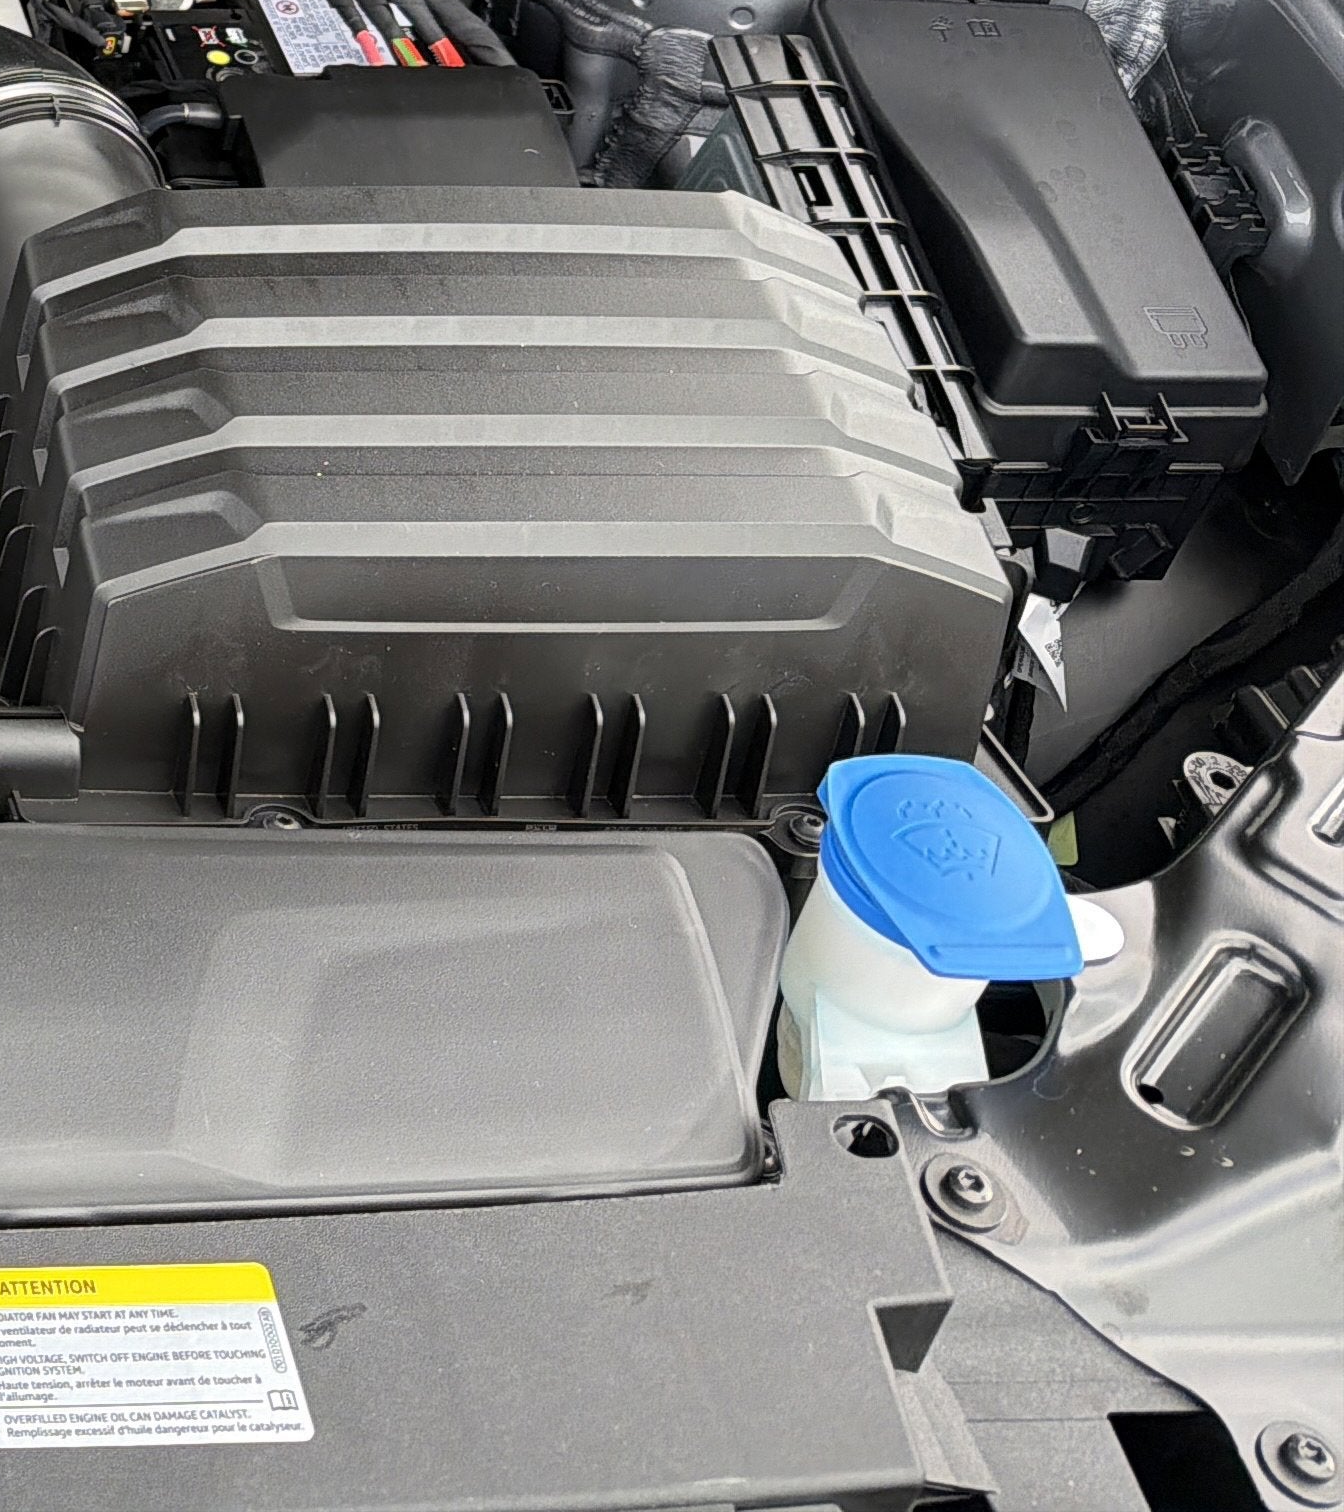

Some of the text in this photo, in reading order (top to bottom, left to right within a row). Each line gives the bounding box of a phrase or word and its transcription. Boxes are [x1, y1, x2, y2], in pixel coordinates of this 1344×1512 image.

[0, 1279, 96, 1295] ATTENTION
[35, 1311, 56, 1321] FAN
[57, 1311, 79, 1320] MAY
[81, 1310, 111, 1320] START
[114, 1309, 125, 1319] AT
[128, 1310, 148, 1318] ANY
[0, 1325, 56, 1335] ventilateur
[58, 1324, 72, 1334] de
[73, 1324, 120, 1333] radiateur
[123, 1324, 147, 1334] peut
[148, 1324, 160, 1332] se
[228, 1321, 251, 1330] tout
[68, 1352, 108, 1363] SWITCH
[109, 1352, 129, 1362] OFF
[131, 1351, 170, 1362] ENGINE
[171, 1350, 212, 1360] BEFORE
[212, 1348, 266, 1359] TOUCHING
[42, 1364, 84, 1375] SYSTEM.
[112, 1377, 123, 1387] le
[125, 1378, 163, 1387] moteur
[166, 1377, 195, 1386] avant
[197, 1375, 210, 1385] de
[212, 1374, 252, 1385] toucher
[3, 1408, 250, 1424] OVERFILLED ENGINE OIL CAN DAMAGE CATALYST.
[6, 1426, 72, 1439] Remplissage
[154, 1424, 208, 1435] dangereux
[211, 1424, 234, 1434] pour
[236, 1421, 247, 1431] le
[248, 1421, 303, 1432] catalyseur.
